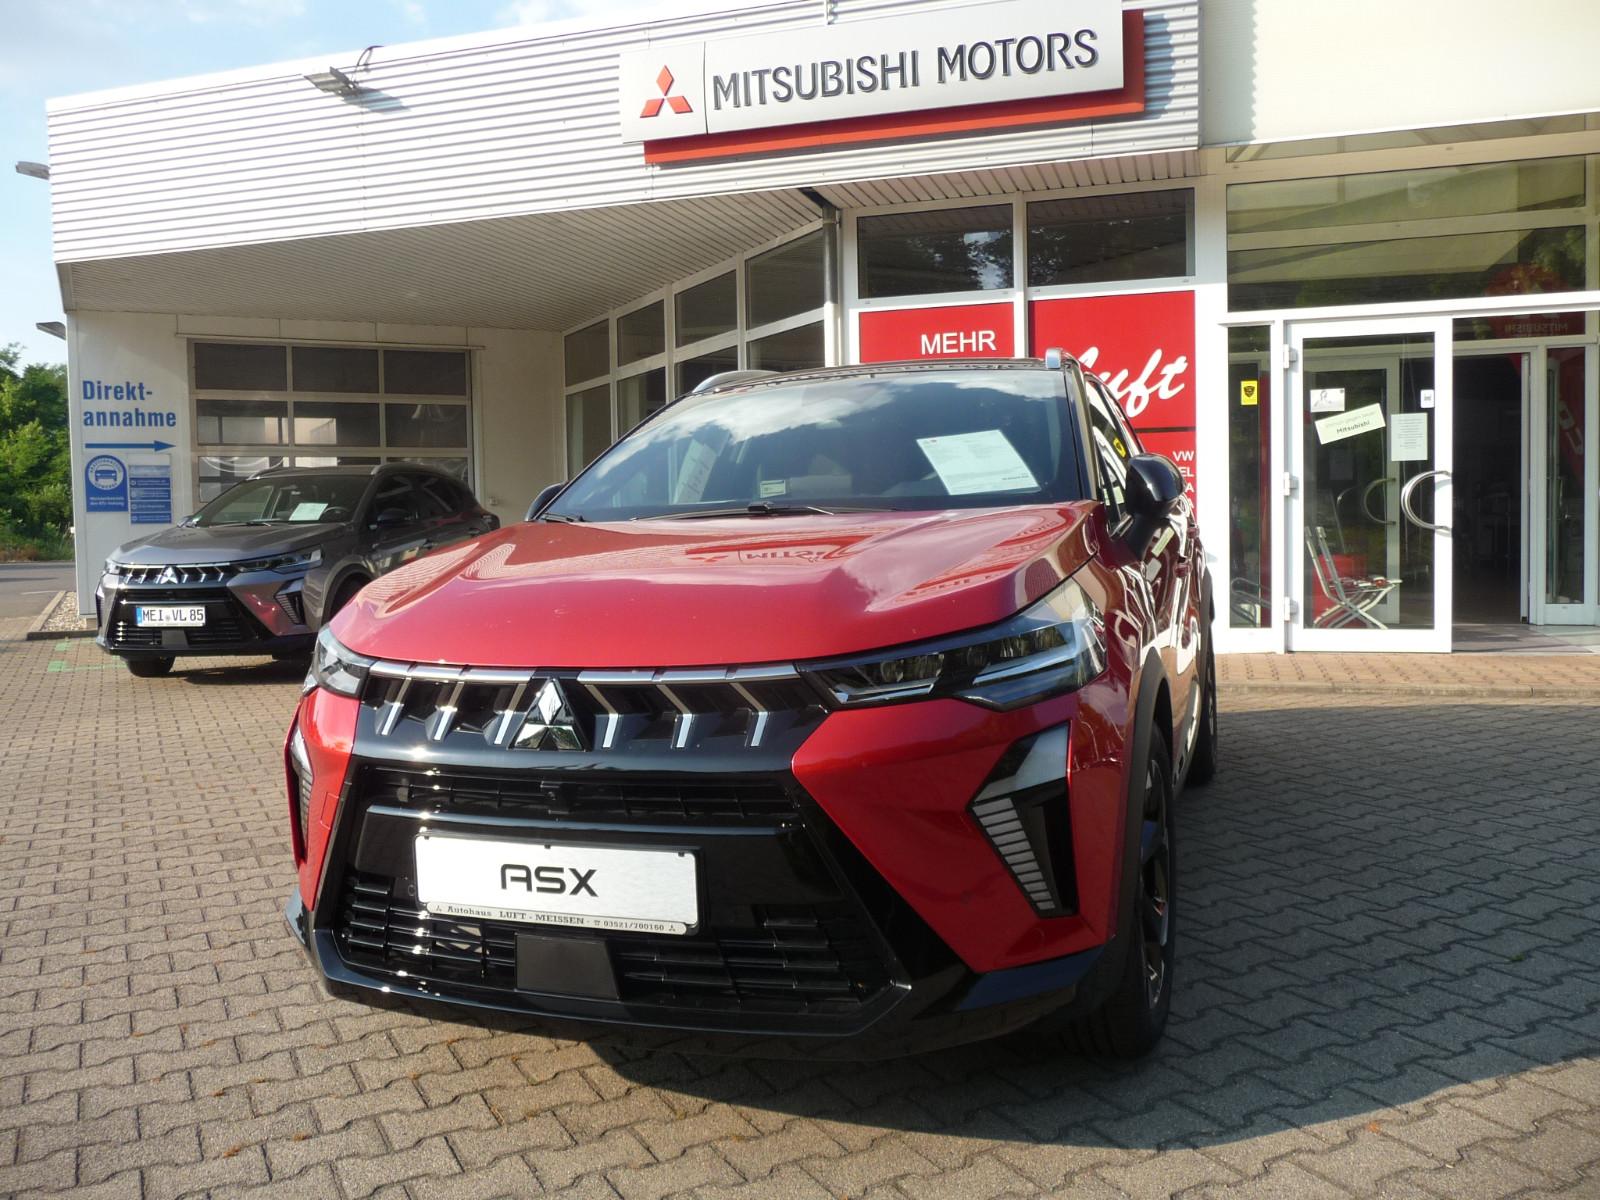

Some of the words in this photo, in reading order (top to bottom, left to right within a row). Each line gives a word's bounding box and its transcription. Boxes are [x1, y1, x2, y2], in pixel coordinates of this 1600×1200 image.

[712, 49, 919, 110] MITSUBISHI
[937, 28, 1099, 84] MOTORS
[921, 330, 997, 355] MEHR
[82, 380, 153, 401] Direkt-
[83, 408, 177, 427] annahme
[1172, 451, 1194, 462] VW
[143, 608, 164, 621] MEI
[190, 608, 204, 621] 85
[500, 863, 599, 898] ASX
[447, 905, 492, 916] Autohaus
[500, 911, 527, 920] LUFT
[535, 914, 584, 925] MEISSEN
